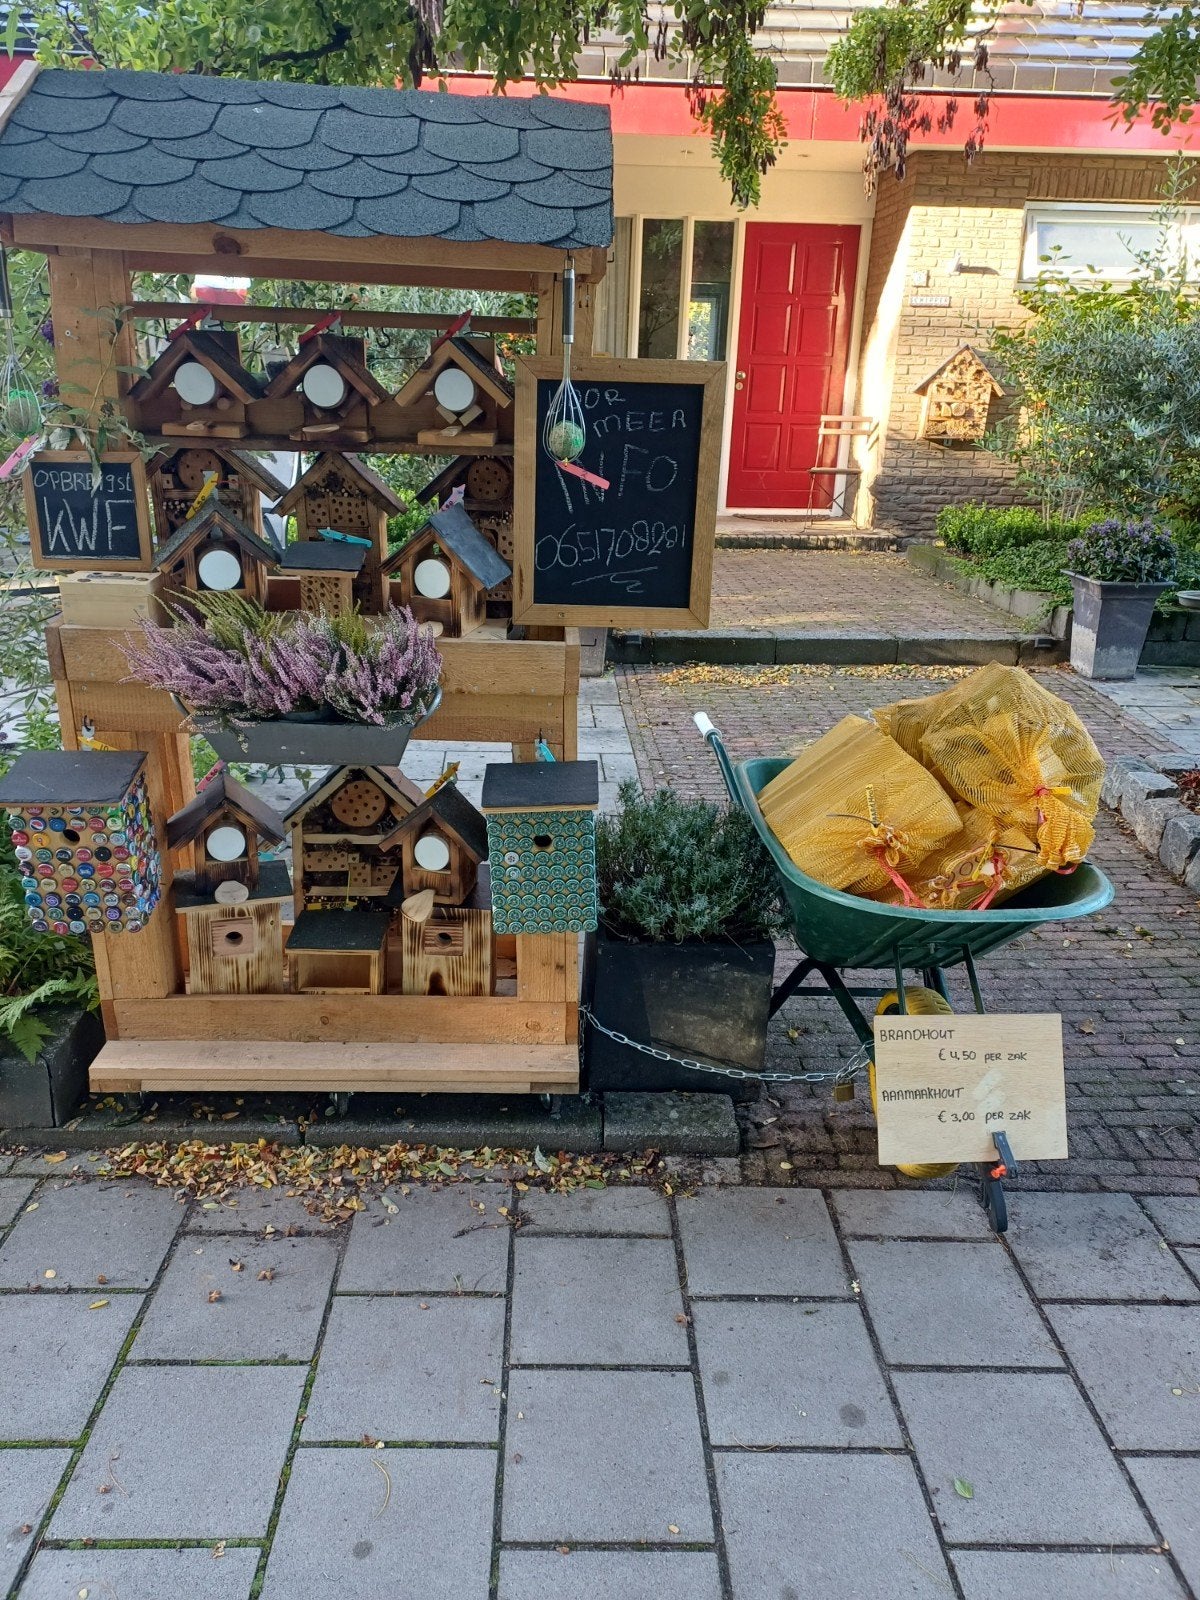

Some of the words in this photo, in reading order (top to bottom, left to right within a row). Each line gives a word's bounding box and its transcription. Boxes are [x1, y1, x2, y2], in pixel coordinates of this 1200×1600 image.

[43, 496, 135, 552] KWF
[880, 1029, 955, 1042] BRANDHOUT
[1007, 1052, 1028, 1061] ZAK
[882, 1087, 964, 1101] AANMAAKHOUT
[1008, 1109, 1031, 1120] ZAK
